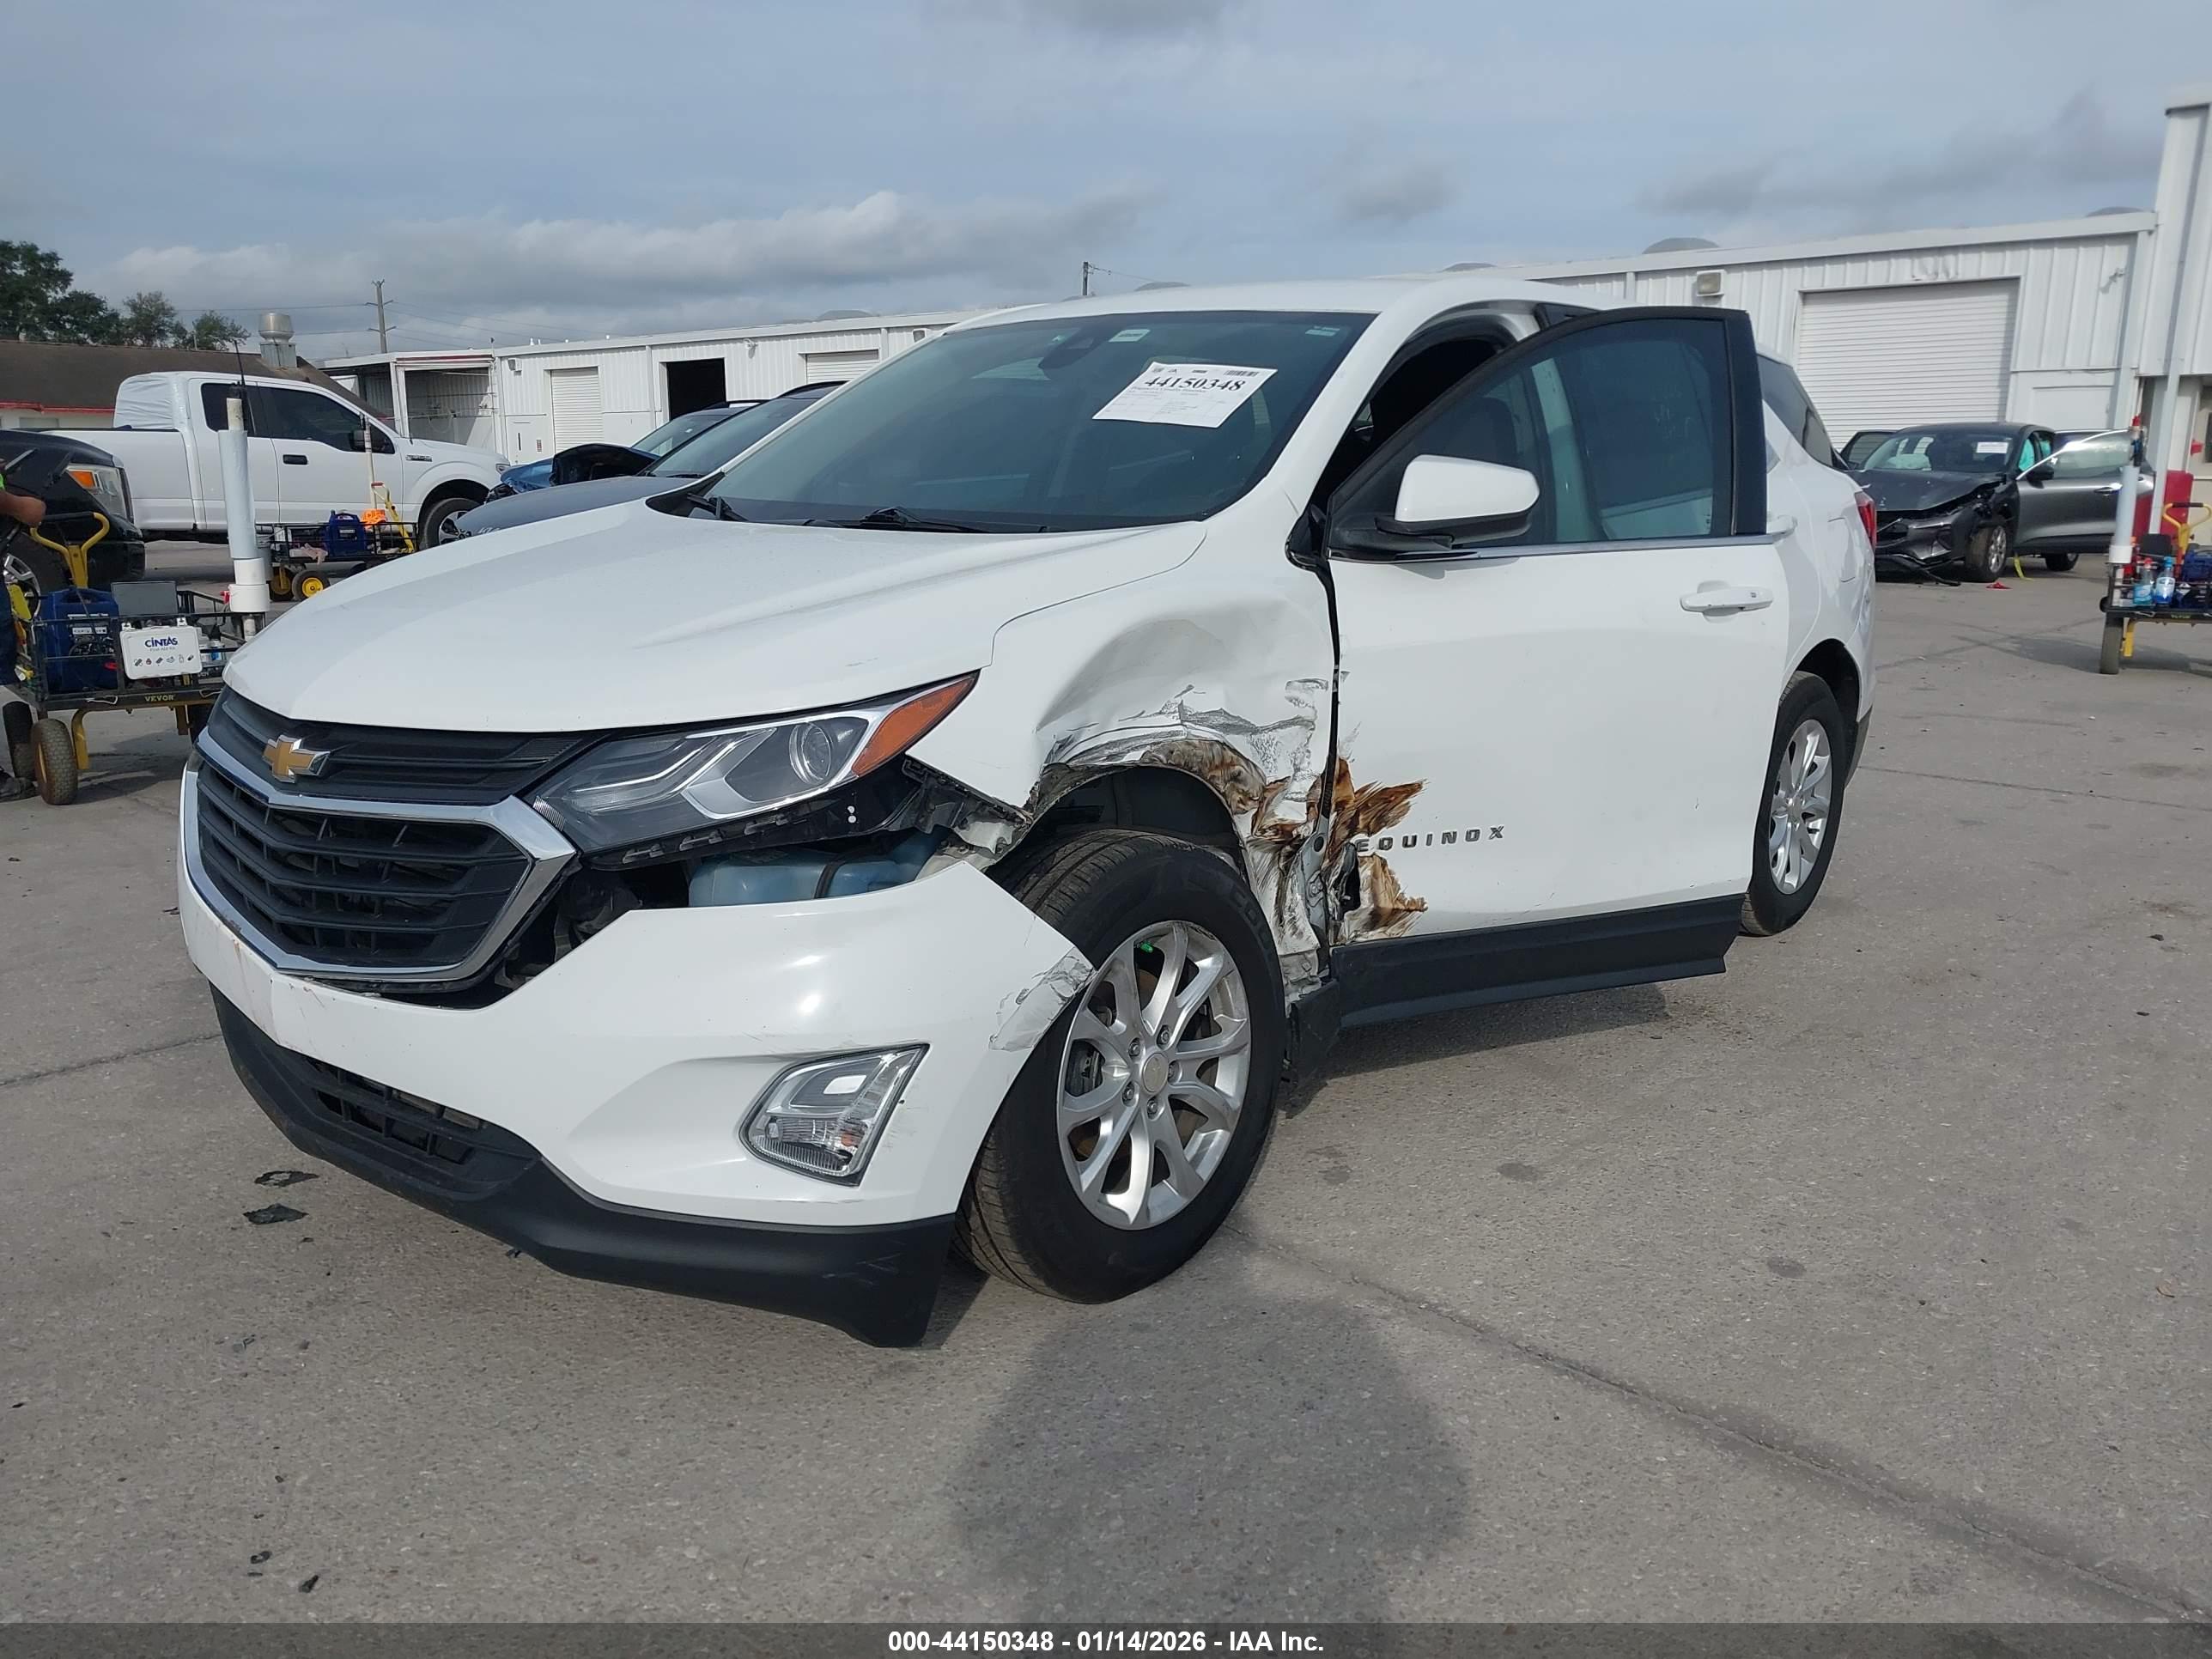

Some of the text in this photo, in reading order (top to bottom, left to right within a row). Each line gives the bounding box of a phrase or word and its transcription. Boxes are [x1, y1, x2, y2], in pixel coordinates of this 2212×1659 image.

[1145, 376, 1247, 392] 44150348
[144, 636, 178, 647] CINTAS
[1355, 825, 1504, 853] EQUINOX
